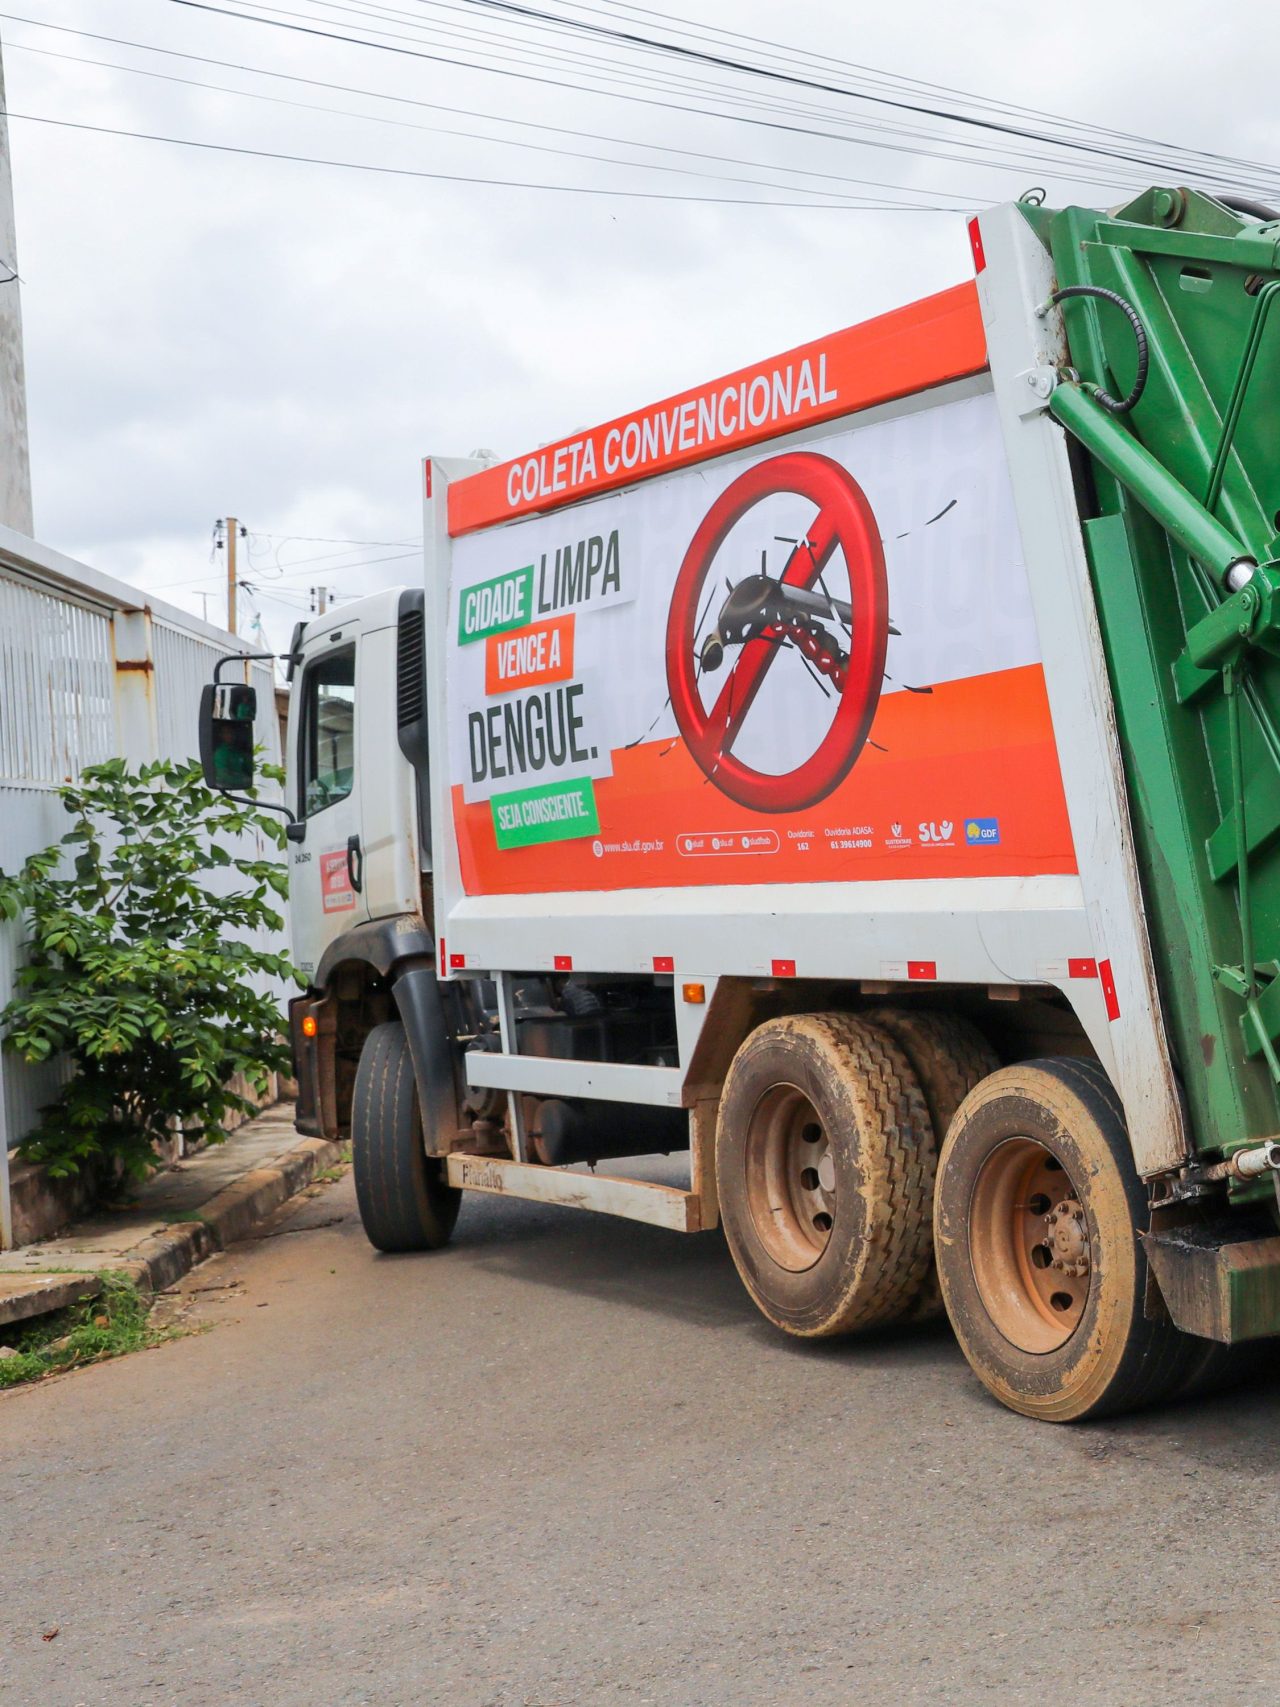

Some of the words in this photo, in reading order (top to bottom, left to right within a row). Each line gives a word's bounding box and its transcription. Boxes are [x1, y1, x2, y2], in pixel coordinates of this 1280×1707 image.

[507, 437, 597, 507] COLETA
[603, 353, 838, 474] CONVENCIONAL
[464, 574, 527, 635] CIDADE
[538, 529, 621, 614] LIMPA
[497, 631, 547, 680] VENCE
[548, 629, 561, 669] A
[468, 683, 599, 783] DENGUE.
[497, 801, 524, 831] SEJA
[521, 791, 590, 827] CONSCIENTE.
[787, 829, 815, 839] Ouvidoria:
[824, 827, 851, 837] Ouvidoria
[852, 826, 875, 836] ADASA:
[918, 820, 954, 842] SLU
[981, 828, 997, 839] GDF
[603, 839, 665, 854] www.slu.df.gov.br
[797, 842, 810, 851] 162
[830, 840, 839, 850] 61
[840, 839, 873, 850] 39614900
